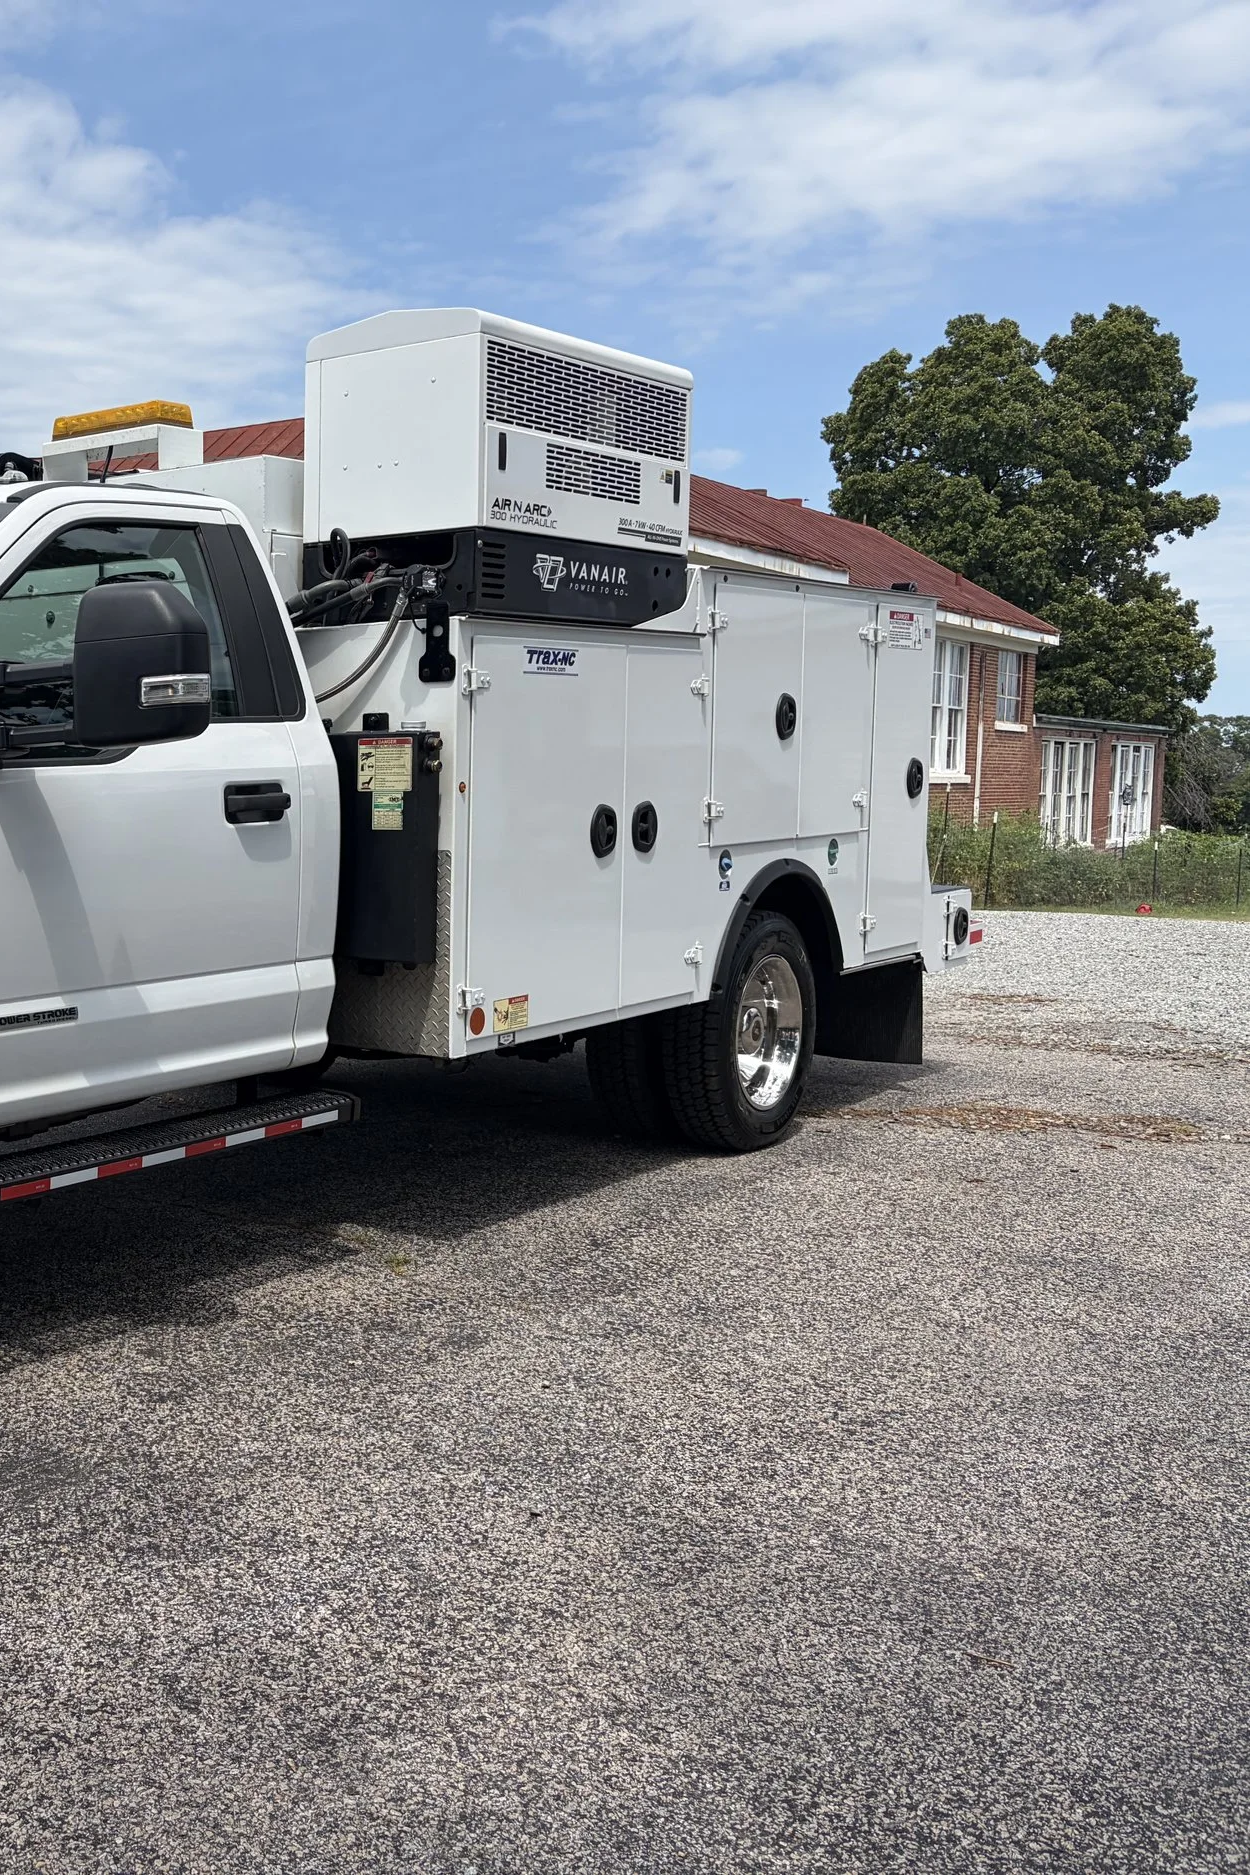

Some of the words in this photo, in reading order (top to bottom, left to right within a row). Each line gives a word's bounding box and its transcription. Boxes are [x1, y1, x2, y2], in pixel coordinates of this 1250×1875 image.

[491, 497, 511, 511] AIR
[513, 500, 523, 513] N
[523, 503, 548, 517] ARC
[490, 510, 507, 521] 300
[510, 513, 558, 529] HYDRAULIC
[570, 560, 626, 584] VANAIR
[569, 582, 595, 593] POWER
[600, 586, 609, 594] TO
[33, 1006, 77, 1021] STROKE
